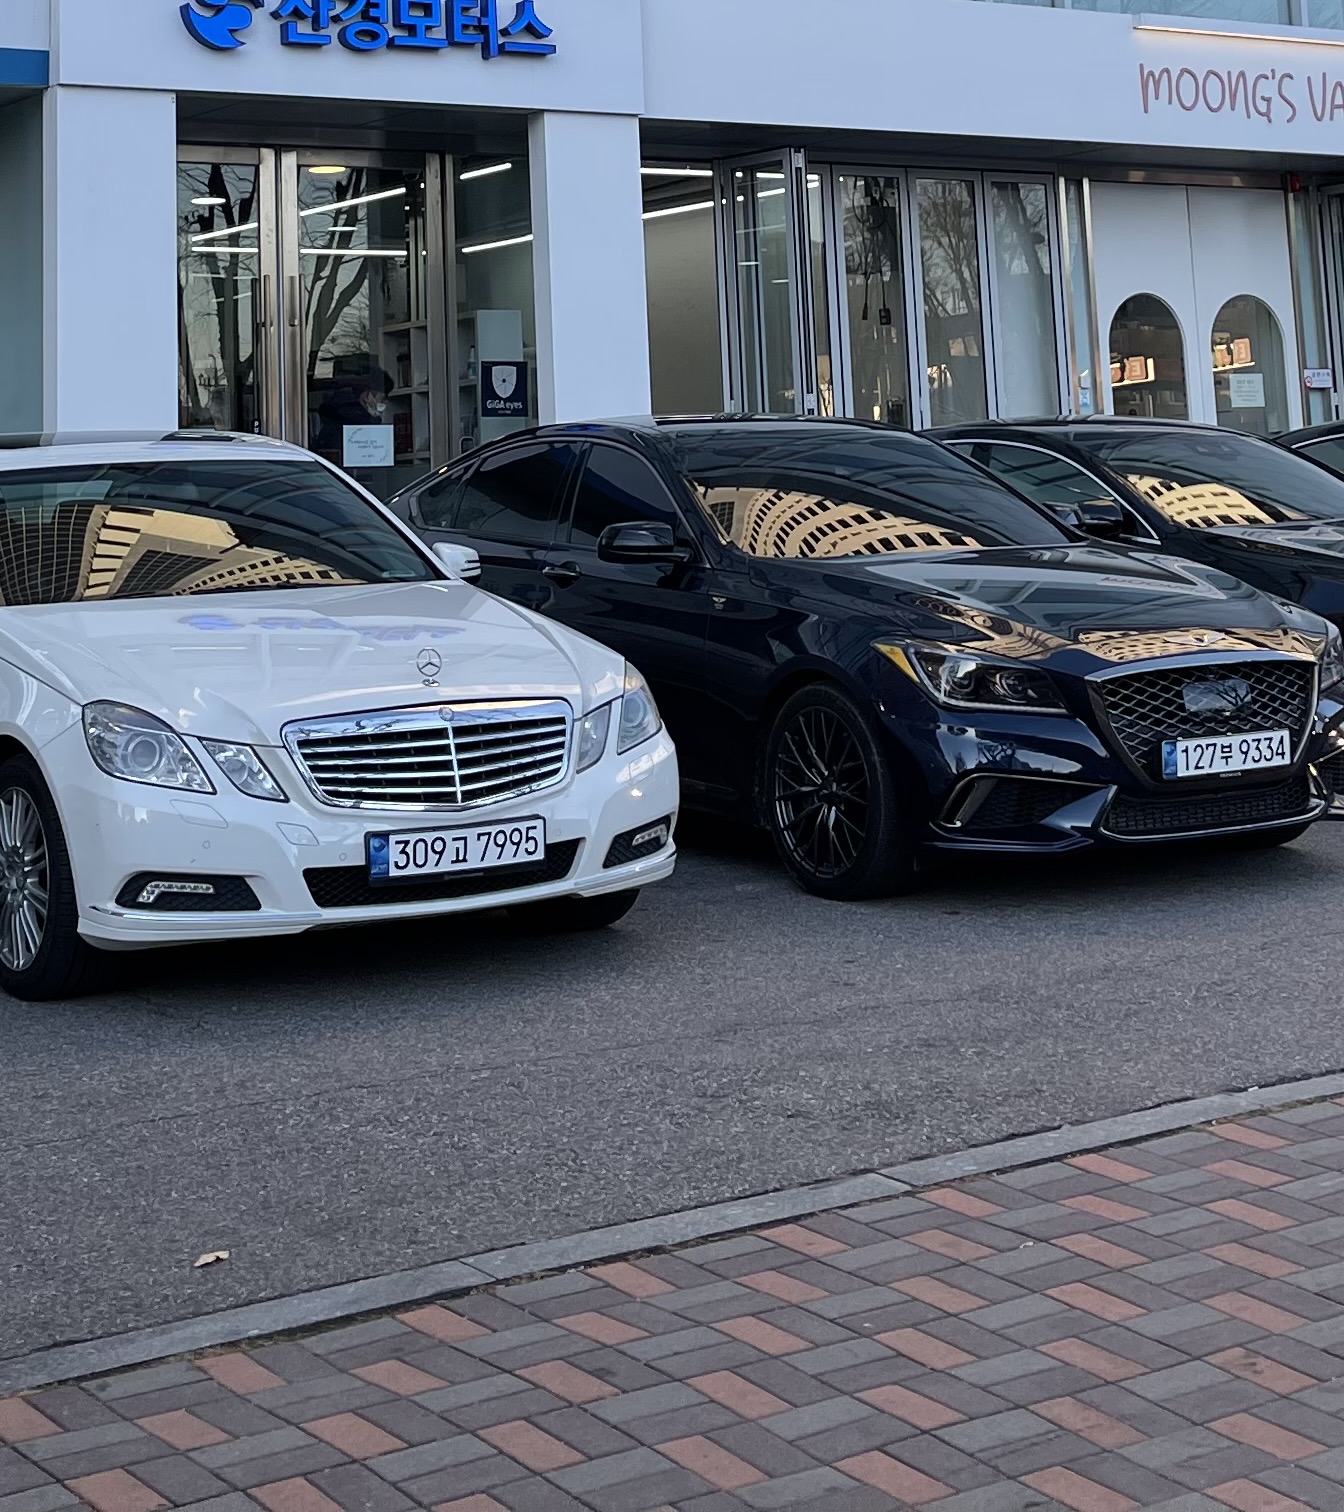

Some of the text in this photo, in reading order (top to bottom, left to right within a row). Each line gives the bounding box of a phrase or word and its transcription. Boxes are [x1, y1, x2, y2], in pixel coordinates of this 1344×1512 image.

[1138, 61, 1297, 124] MOONG'S
[1181, 735, 1286, 771] 127부 9334
[393, 825, 539, 871] 309고 7995
